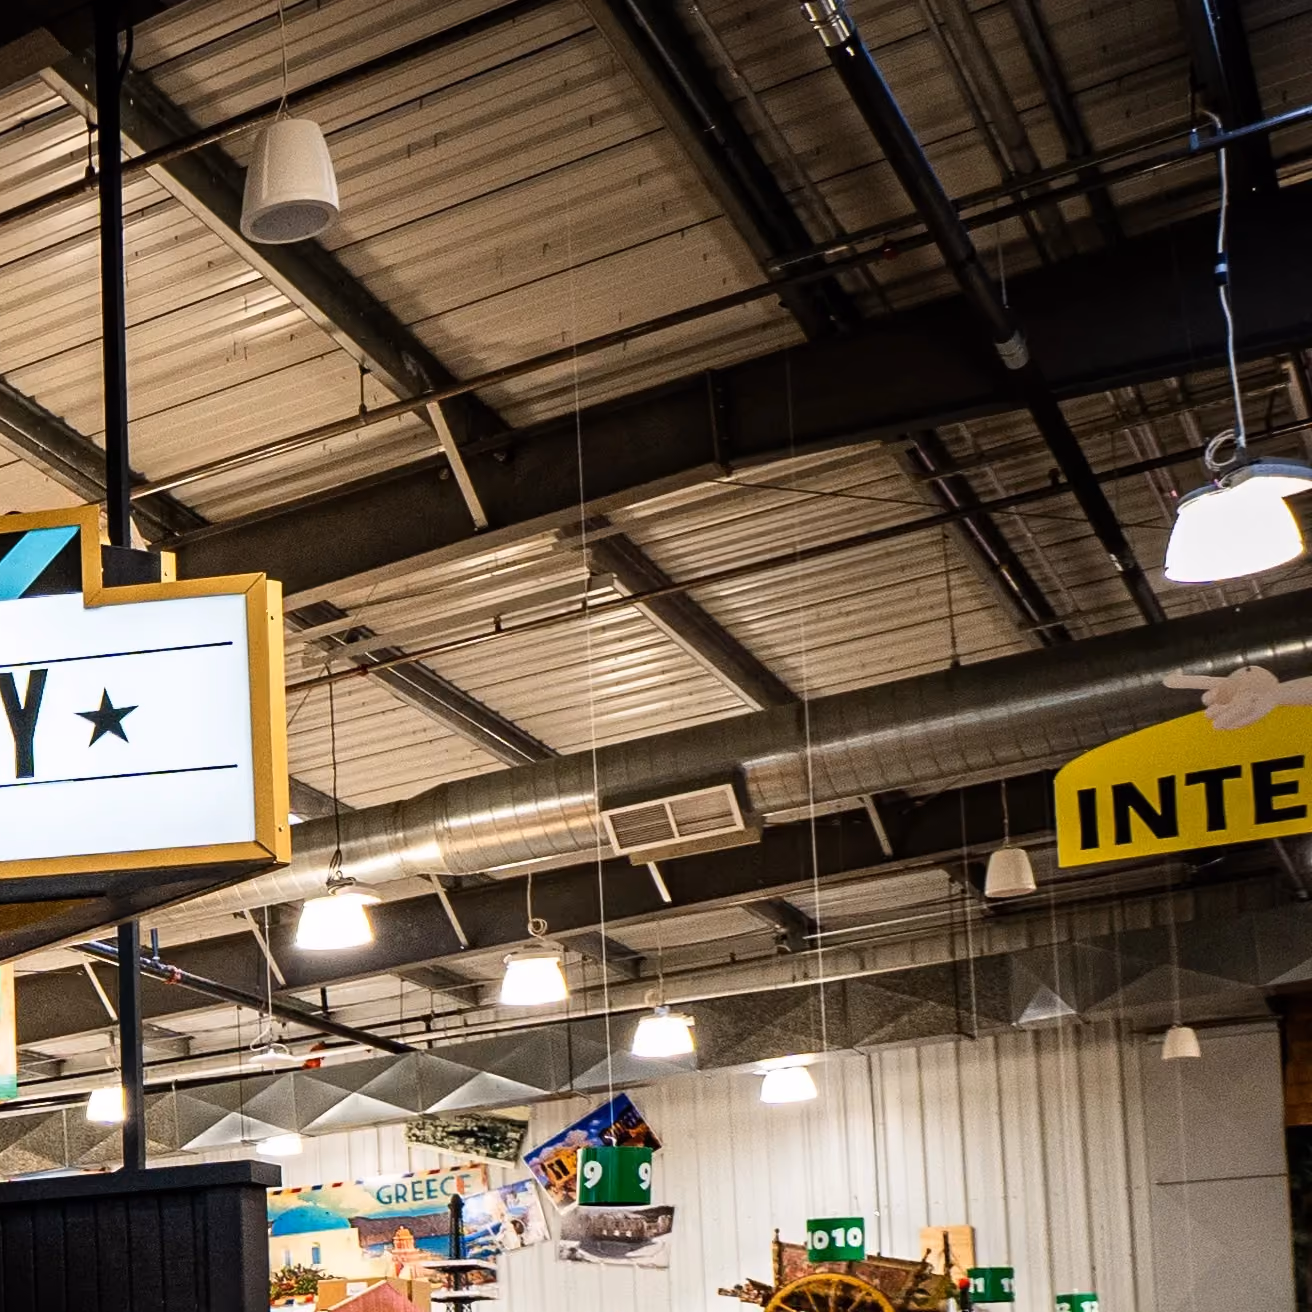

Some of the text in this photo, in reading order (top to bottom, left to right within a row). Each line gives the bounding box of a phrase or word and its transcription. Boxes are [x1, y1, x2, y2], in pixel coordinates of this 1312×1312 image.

[584, 1159, 603, 1189] 9
[638, 1162, 652, 1190] 9
[376, 1173, 472, 1205] GREECE
[831, 1226, 863, 1249] 10
